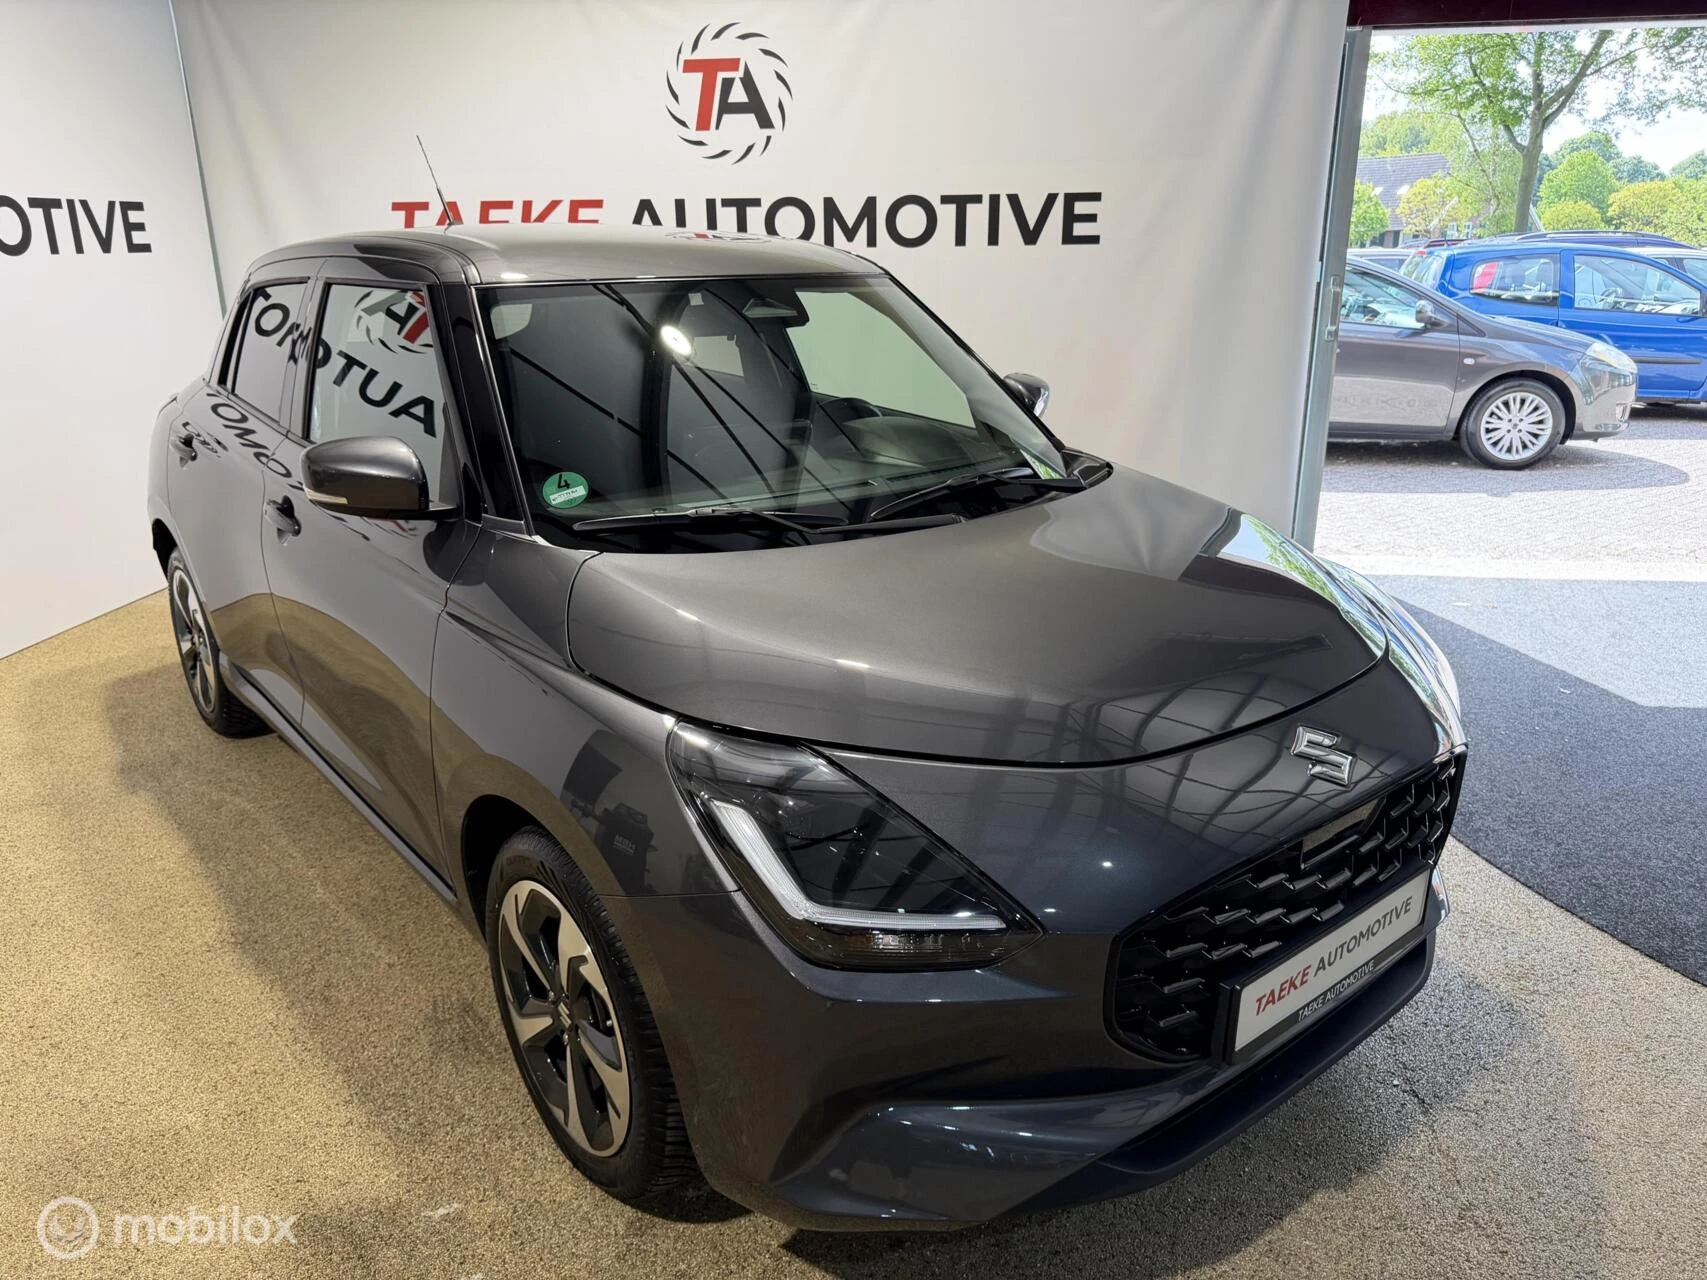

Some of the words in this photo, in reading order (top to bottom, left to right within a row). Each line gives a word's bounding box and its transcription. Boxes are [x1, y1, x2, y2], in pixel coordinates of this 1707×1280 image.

[682, 57, 776, 131] TA
[632, 191, 1102, 249] AUTOMOTIVE
[557, 473, 571, 490] 4
[1256, 965, 1311, 1016] TAEKE
[1314, 896, 1413, 978] AUTOMOTIVE
[1298, 995, 1324, 1021] TAEKE
[1325, 959, 1375, 1004] AUTOMOTIVE
